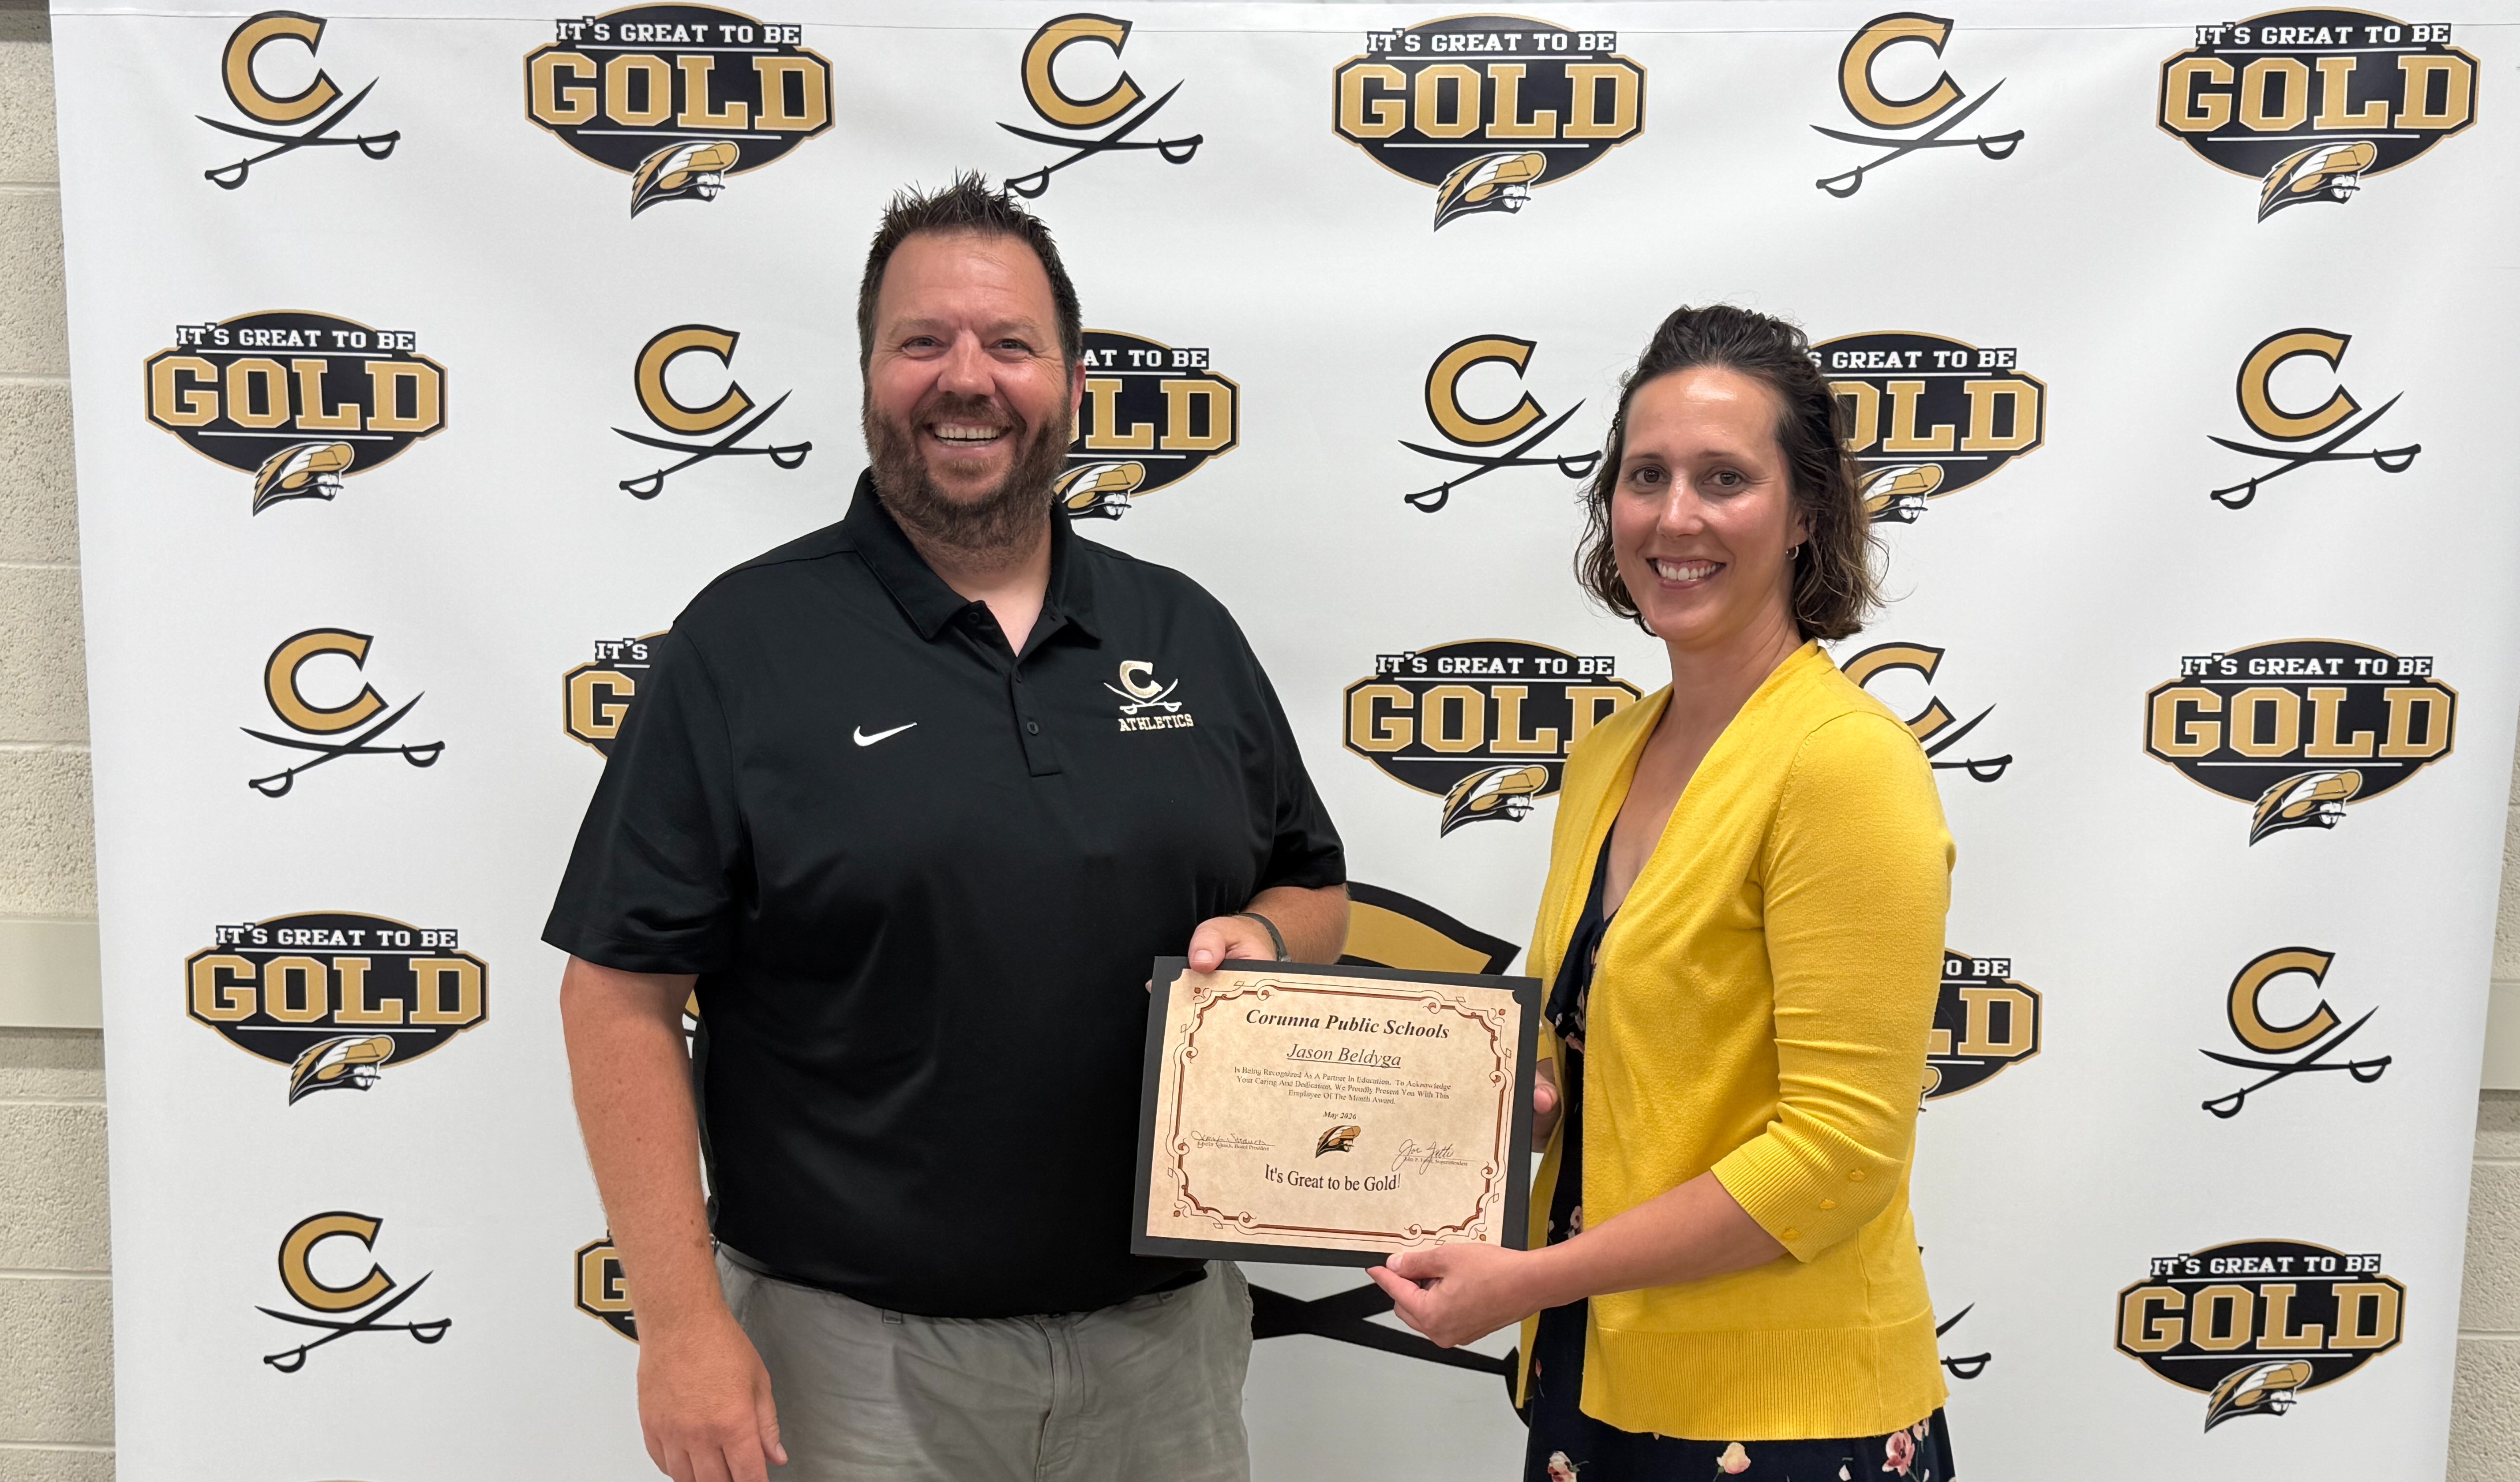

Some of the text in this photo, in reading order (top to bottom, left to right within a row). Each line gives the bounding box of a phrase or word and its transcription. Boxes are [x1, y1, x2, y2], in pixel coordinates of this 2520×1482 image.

[559, 18, 799, 44] IT'S GREAT TO BE
[1369, 30, 1614, 52] IT'S GREAT TO BE
[2198, 24, 2449, 45] IT'S GREAT TO BE
[221, 10, 343, 126] C
[1021, 13, 1146, 130] C
[1838, 12, 1965, 130] C
[532, 52, 826, 131] GOLD
[1341, 65, 1638, 138] GOLD
[2166, 56, 2471, 131] GOLD
[178, 325, 413, 350] IT'S GREAT TO BE
[1128, 350, 1162, 367] TO
[1172, 350, 1207, 367] BE
[1832, 351, 1922, 368] GREAT
[1933, 351, 1968, 368] TO
[1977, 350, 2014, 367] BE
[153, 356, 439, 431] GOLD
[634, 324, 756, 436] C
[1425, 334, 1547, 447] C
[2236, 328, 2362, 442] C
[1070, 379, 1232, 450] LD
[1828, 380, 2039, 452] OLD
[597, 640, 648, 660] IT'S
[1378, 654, 1612, 674] IT'S GREAT TO BE
[2183, 655, 2431, 675] IT'S GREAT TO BE
[264, 628, 389, 735] C
[1119, 660, 1163, 699] C
[1118, 713, 1194, 732] ATHLETICS
[2152, 688, 2450, 757] GOLD
[218, 924, 456, 947] IT'S GREAT TO BE
[1972, 960, 2008, 977] BE
[193, 955, 481, 1025] GOLD
[2227, 947, 2341, 1055] C
[1246, 1009, 1450, 1039] Corunna Public Schools
[1286, 1044, 1401, 1068] Jason Beldyga
[1242, 1067, 1261, 1076] Being
[1264, 1068, 1302, 1078] Recognized
[1323, 1074, 1346, 1082] Partner
[1406, 1081, 1451, 1091] Acknowledge
[1255, 1078, 1277, 1087] Caring
[1348, 1085, 1373, 1094] Proudly
[1288, 1089, 1321, 1099] Employee
[1323, 1111, 1339, 1119] May
[1265, 1163, 1401, 1191] It's Great to be Gold!
[278, 1211, 396, 1314] C
[2152, 1256, 2379, 1275] IT'S GREAT TO BE
[2122, 1283, 2399, 1353] GOLD
